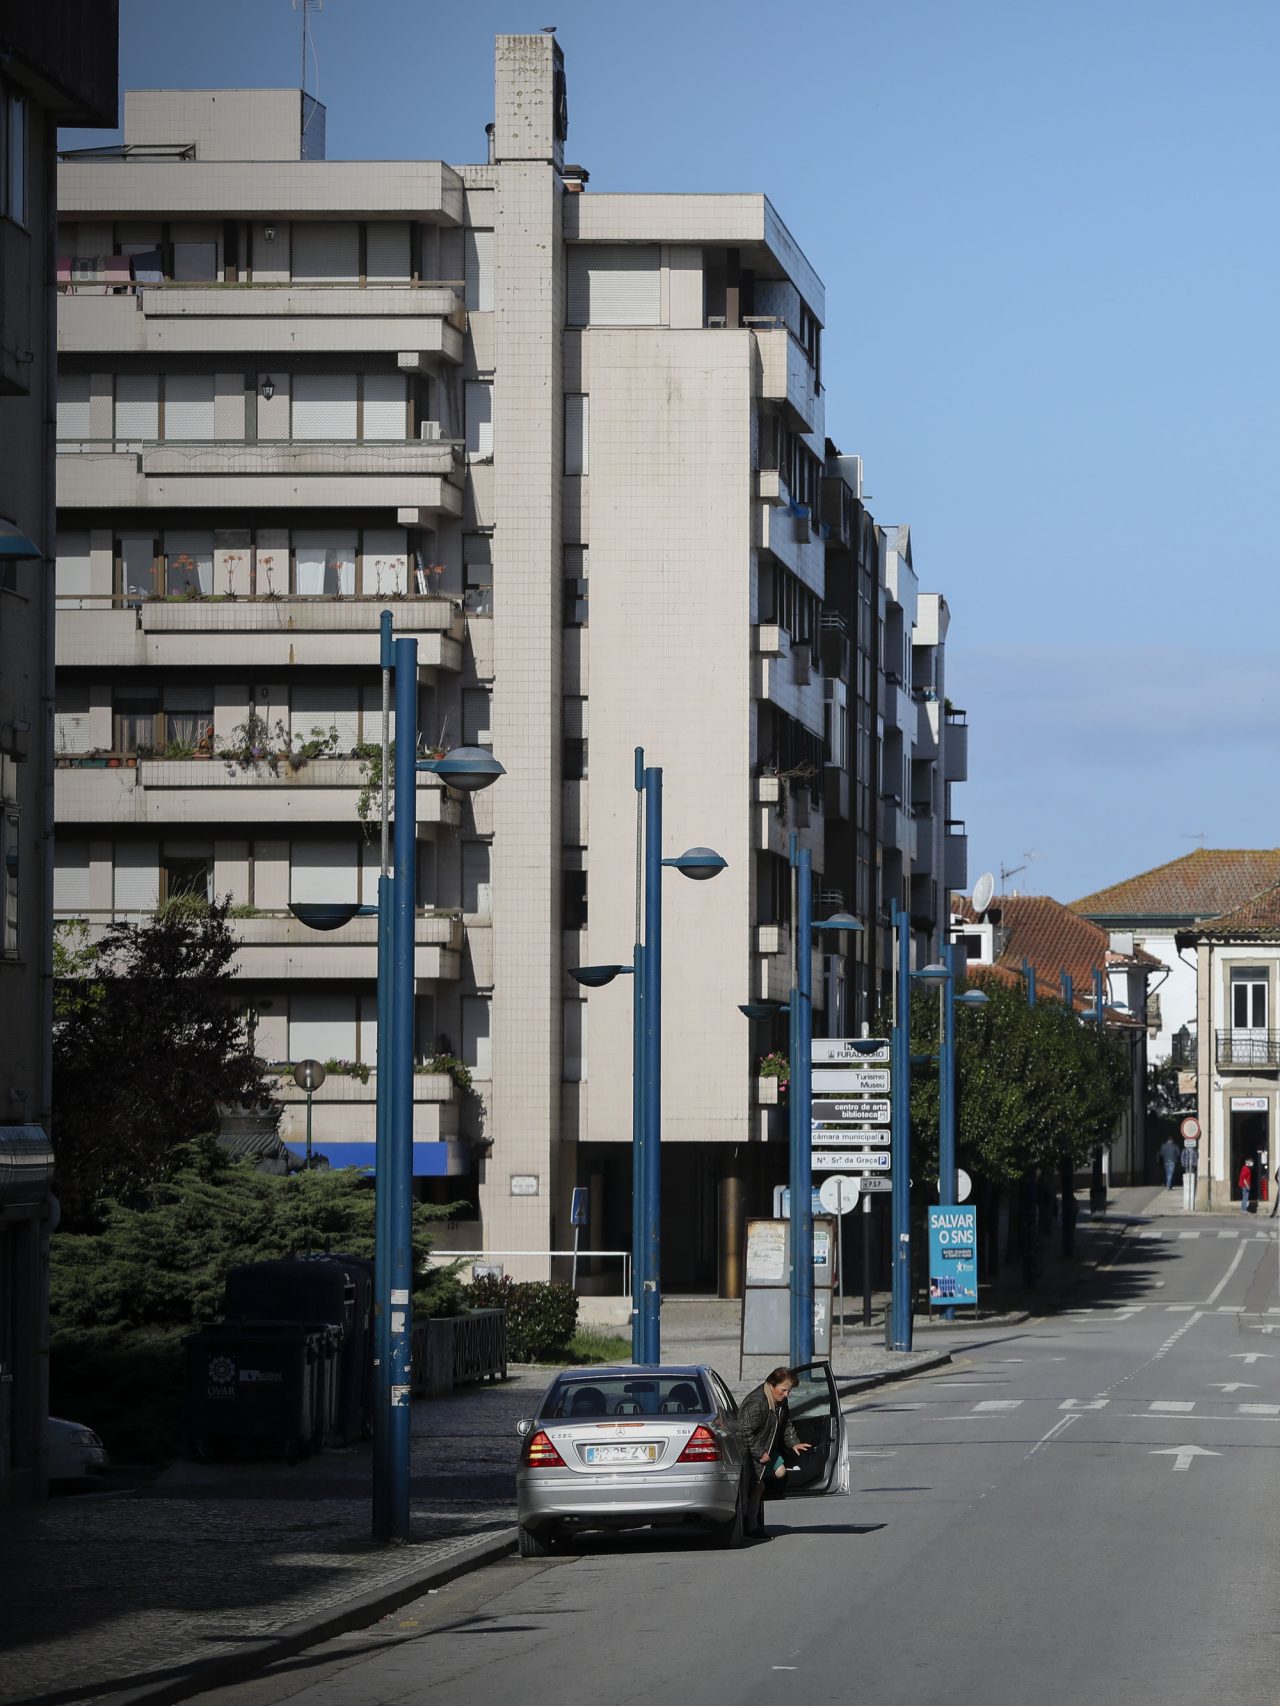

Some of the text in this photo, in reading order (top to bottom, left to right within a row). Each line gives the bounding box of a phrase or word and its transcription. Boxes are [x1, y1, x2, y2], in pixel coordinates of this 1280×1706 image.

[860, 1081, 885, 1089] Museu
[834, 1103, 859, 1111] centro
[860, 1103, 871, 1111] de
[841, 1110, 878, 1118] biblioteca
[842, 1133, 878, 1142] municipal
[856, 1156, 878, 1165] Graça
[931, 1214, 974, 1229] SALVAR
[939, 1229, 974, 1244] O SNS
[207, 1386, 236, 1396] OVAR
